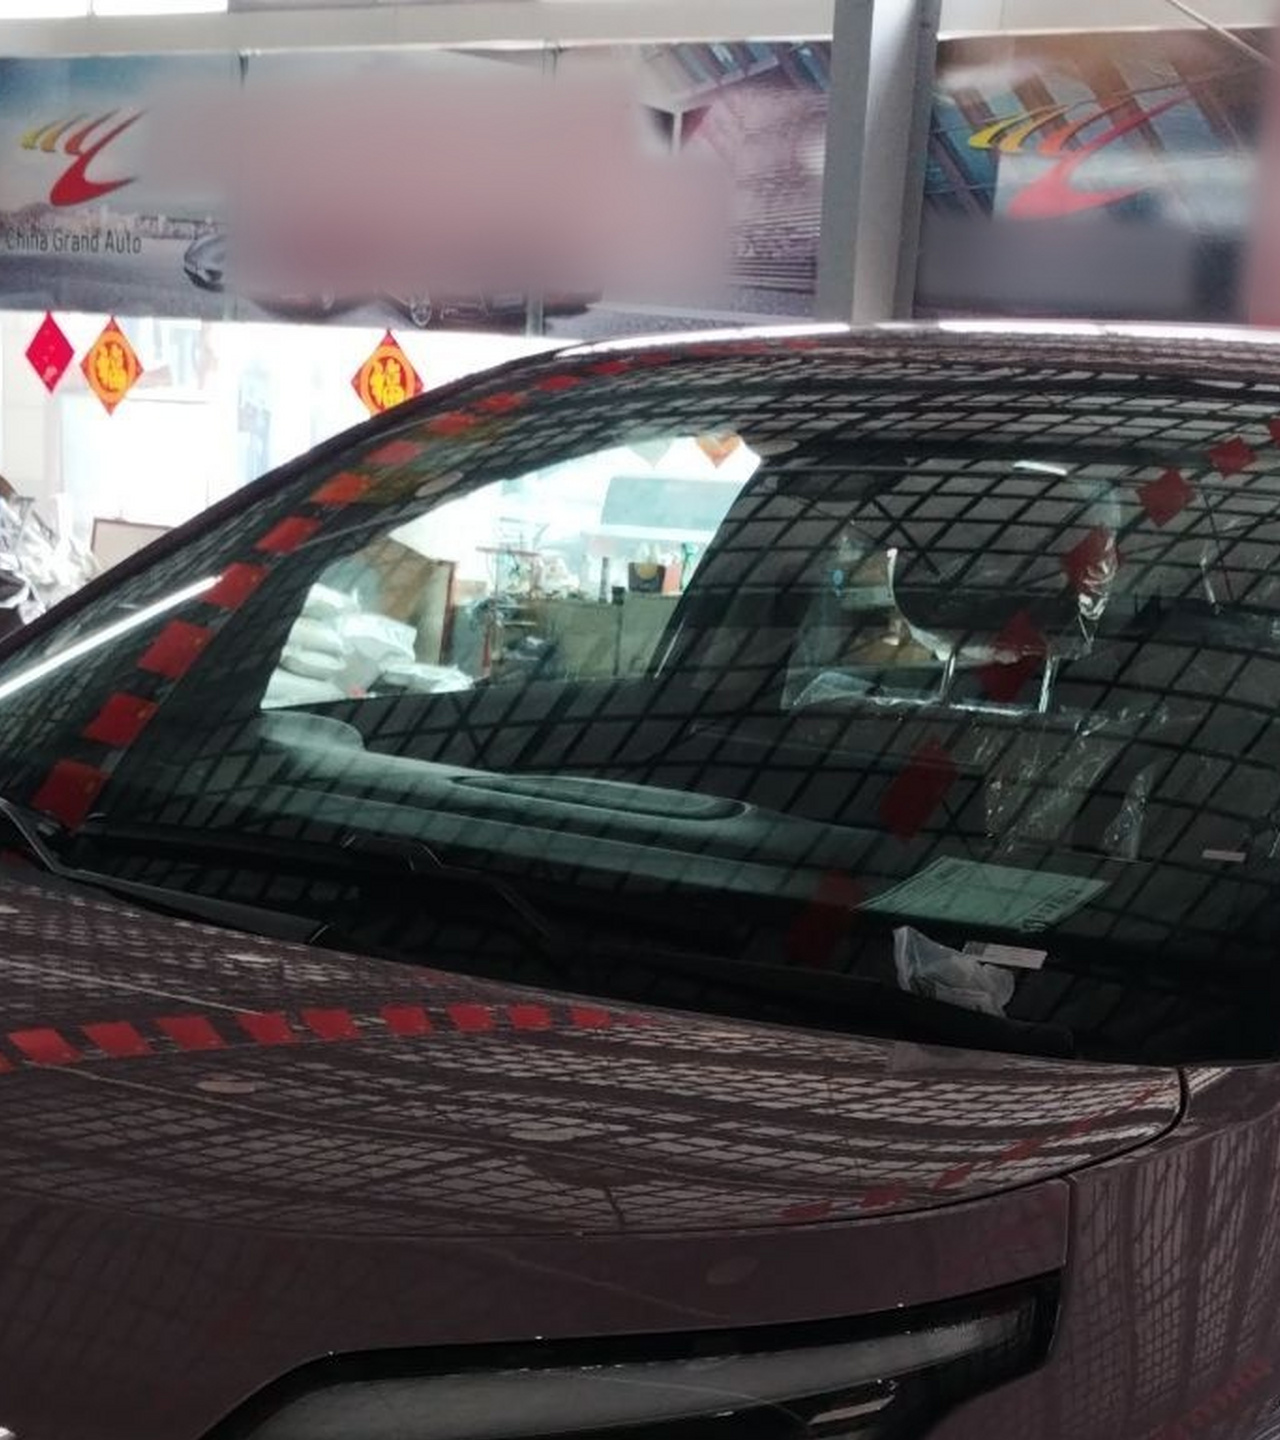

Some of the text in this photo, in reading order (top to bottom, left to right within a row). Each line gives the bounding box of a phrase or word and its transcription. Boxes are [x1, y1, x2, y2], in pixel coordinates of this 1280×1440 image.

[6, 226, 142, 254] China Grand Auto
[368, 356, 406, 409] 福
